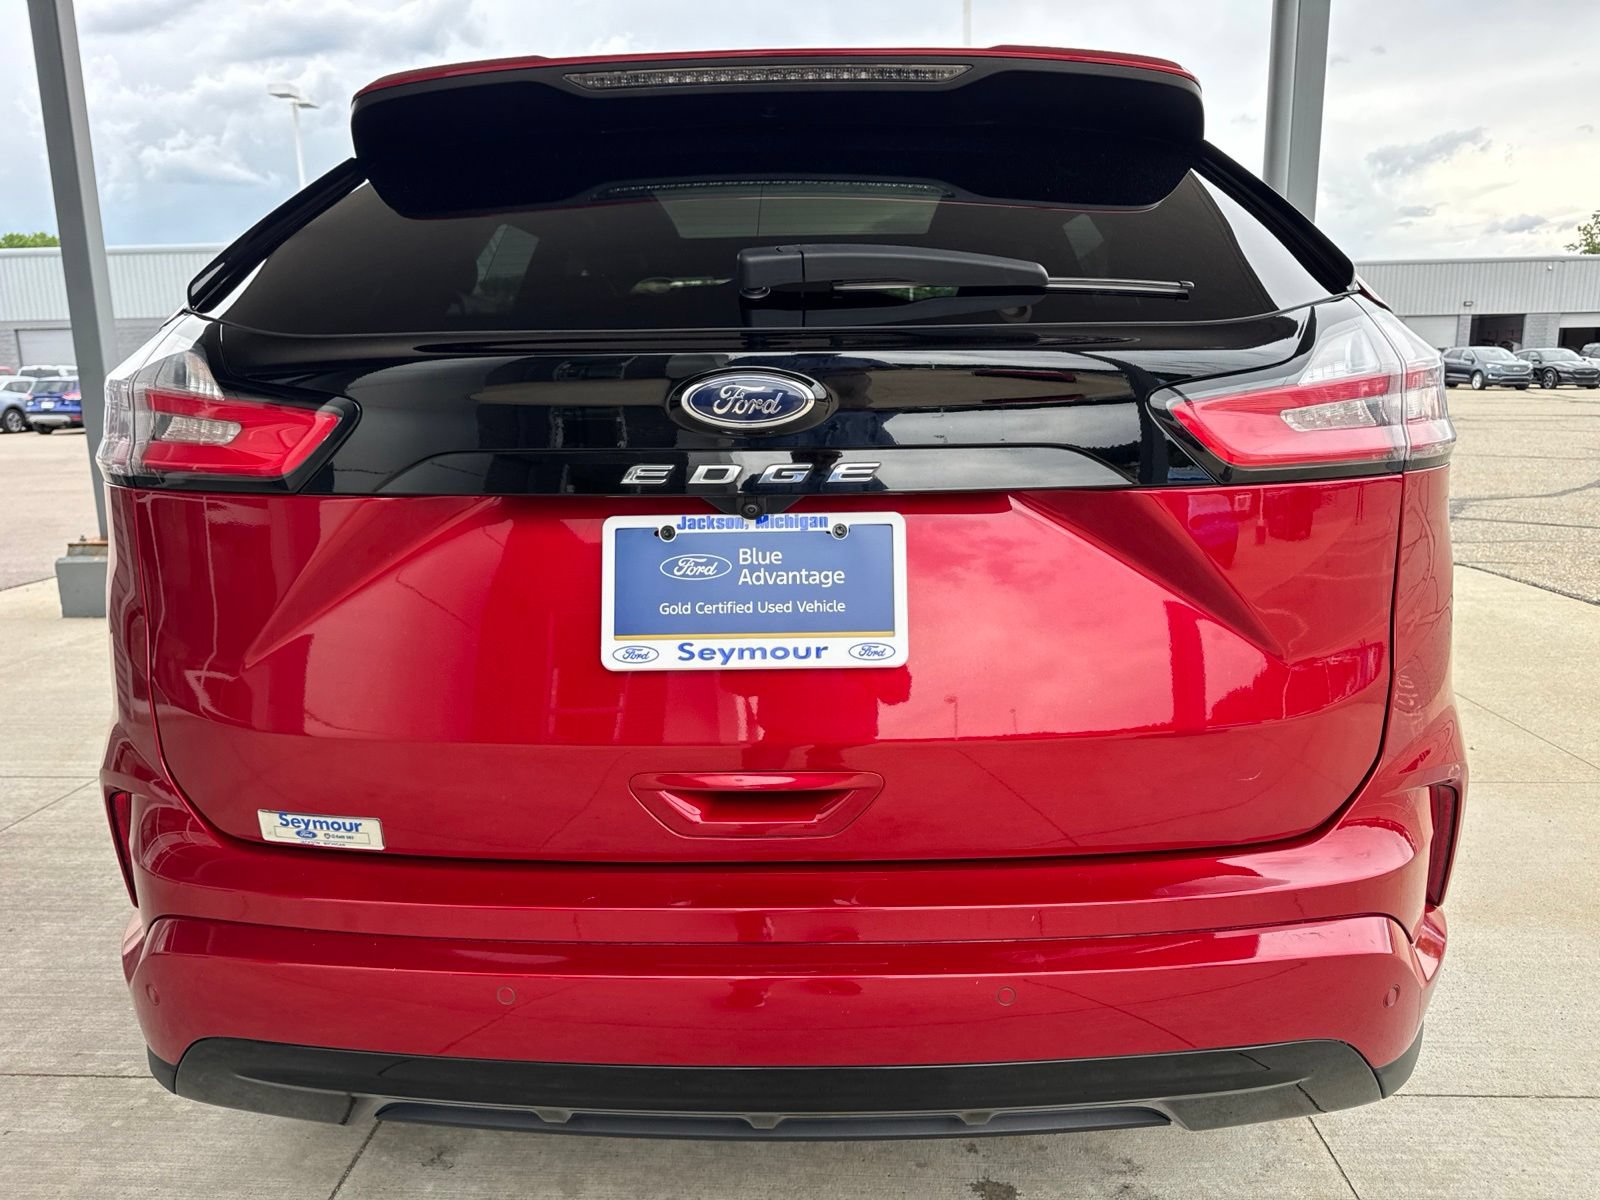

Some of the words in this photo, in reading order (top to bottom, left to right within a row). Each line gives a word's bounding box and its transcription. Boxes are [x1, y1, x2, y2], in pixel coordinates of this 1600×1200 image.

[713, 385, 783, 416] Ford
[620, 461, 881, 485] EDGE
[755, 514, 829, 531] Michigan
[739, 548, 783, 565] Blue
[673, 557, 718, 577] Ford
[738, 568, 846, 588] Advantage
[659, 602, 691, 615] Gold
[695, 601, 753, 615] Certified
[757, 601, 793, 614] Used
[797, 600, 846, 613] Vehicle
[677, 643, 829, 665] Seymour
[278, 812, 362, 832] Seymour
